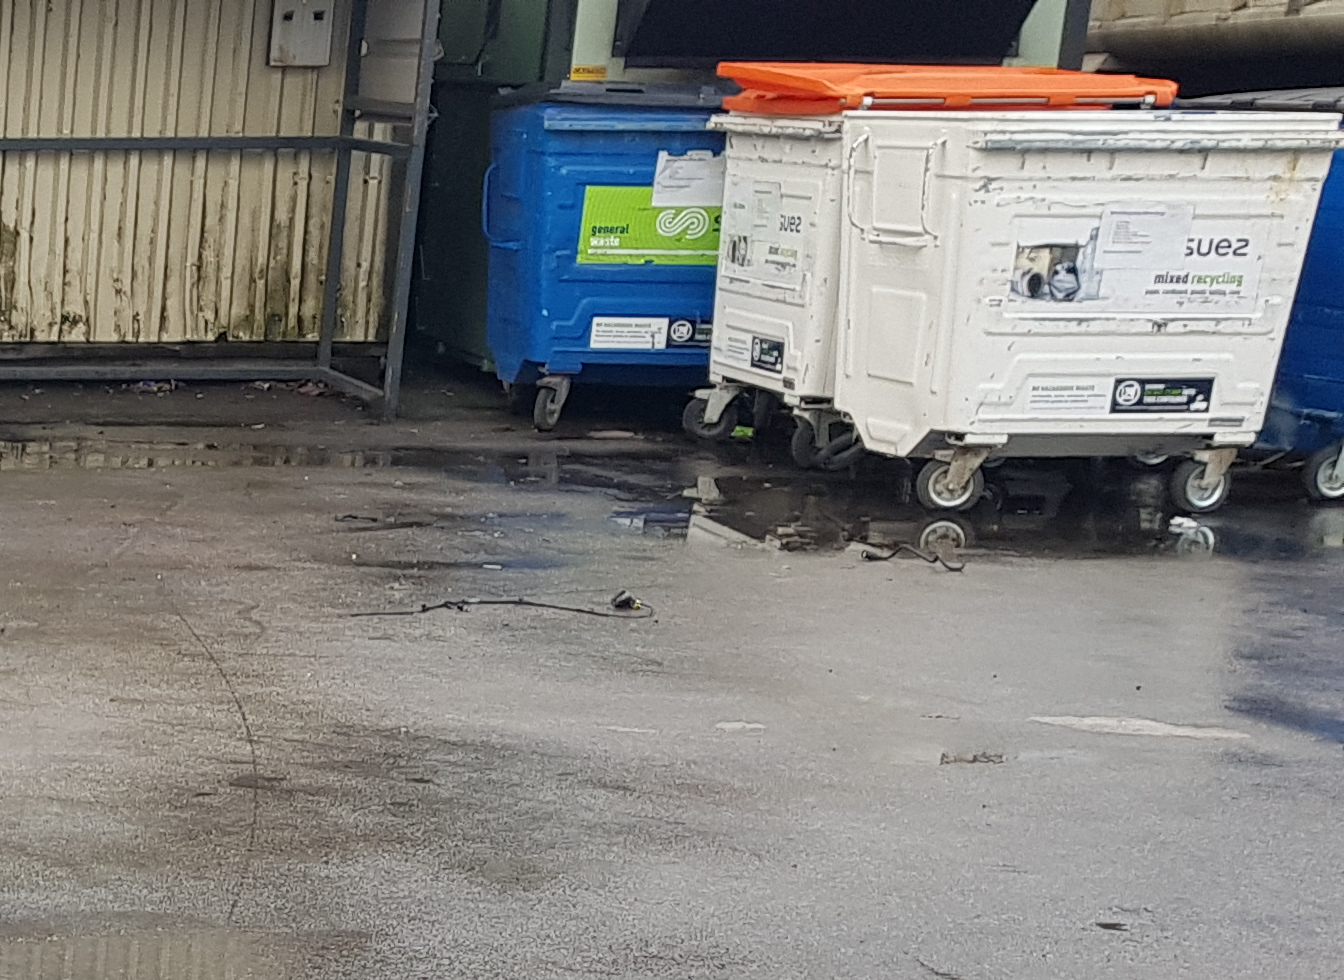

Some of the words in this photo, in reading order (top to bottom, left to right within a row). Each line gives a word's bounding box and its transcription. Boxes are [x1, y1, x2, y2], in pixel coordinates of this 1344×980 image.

[591, 224, 630, 236] general
[1154, 271, 1190, 285] mixed
[1191, 272, 1244, 287] recycling
